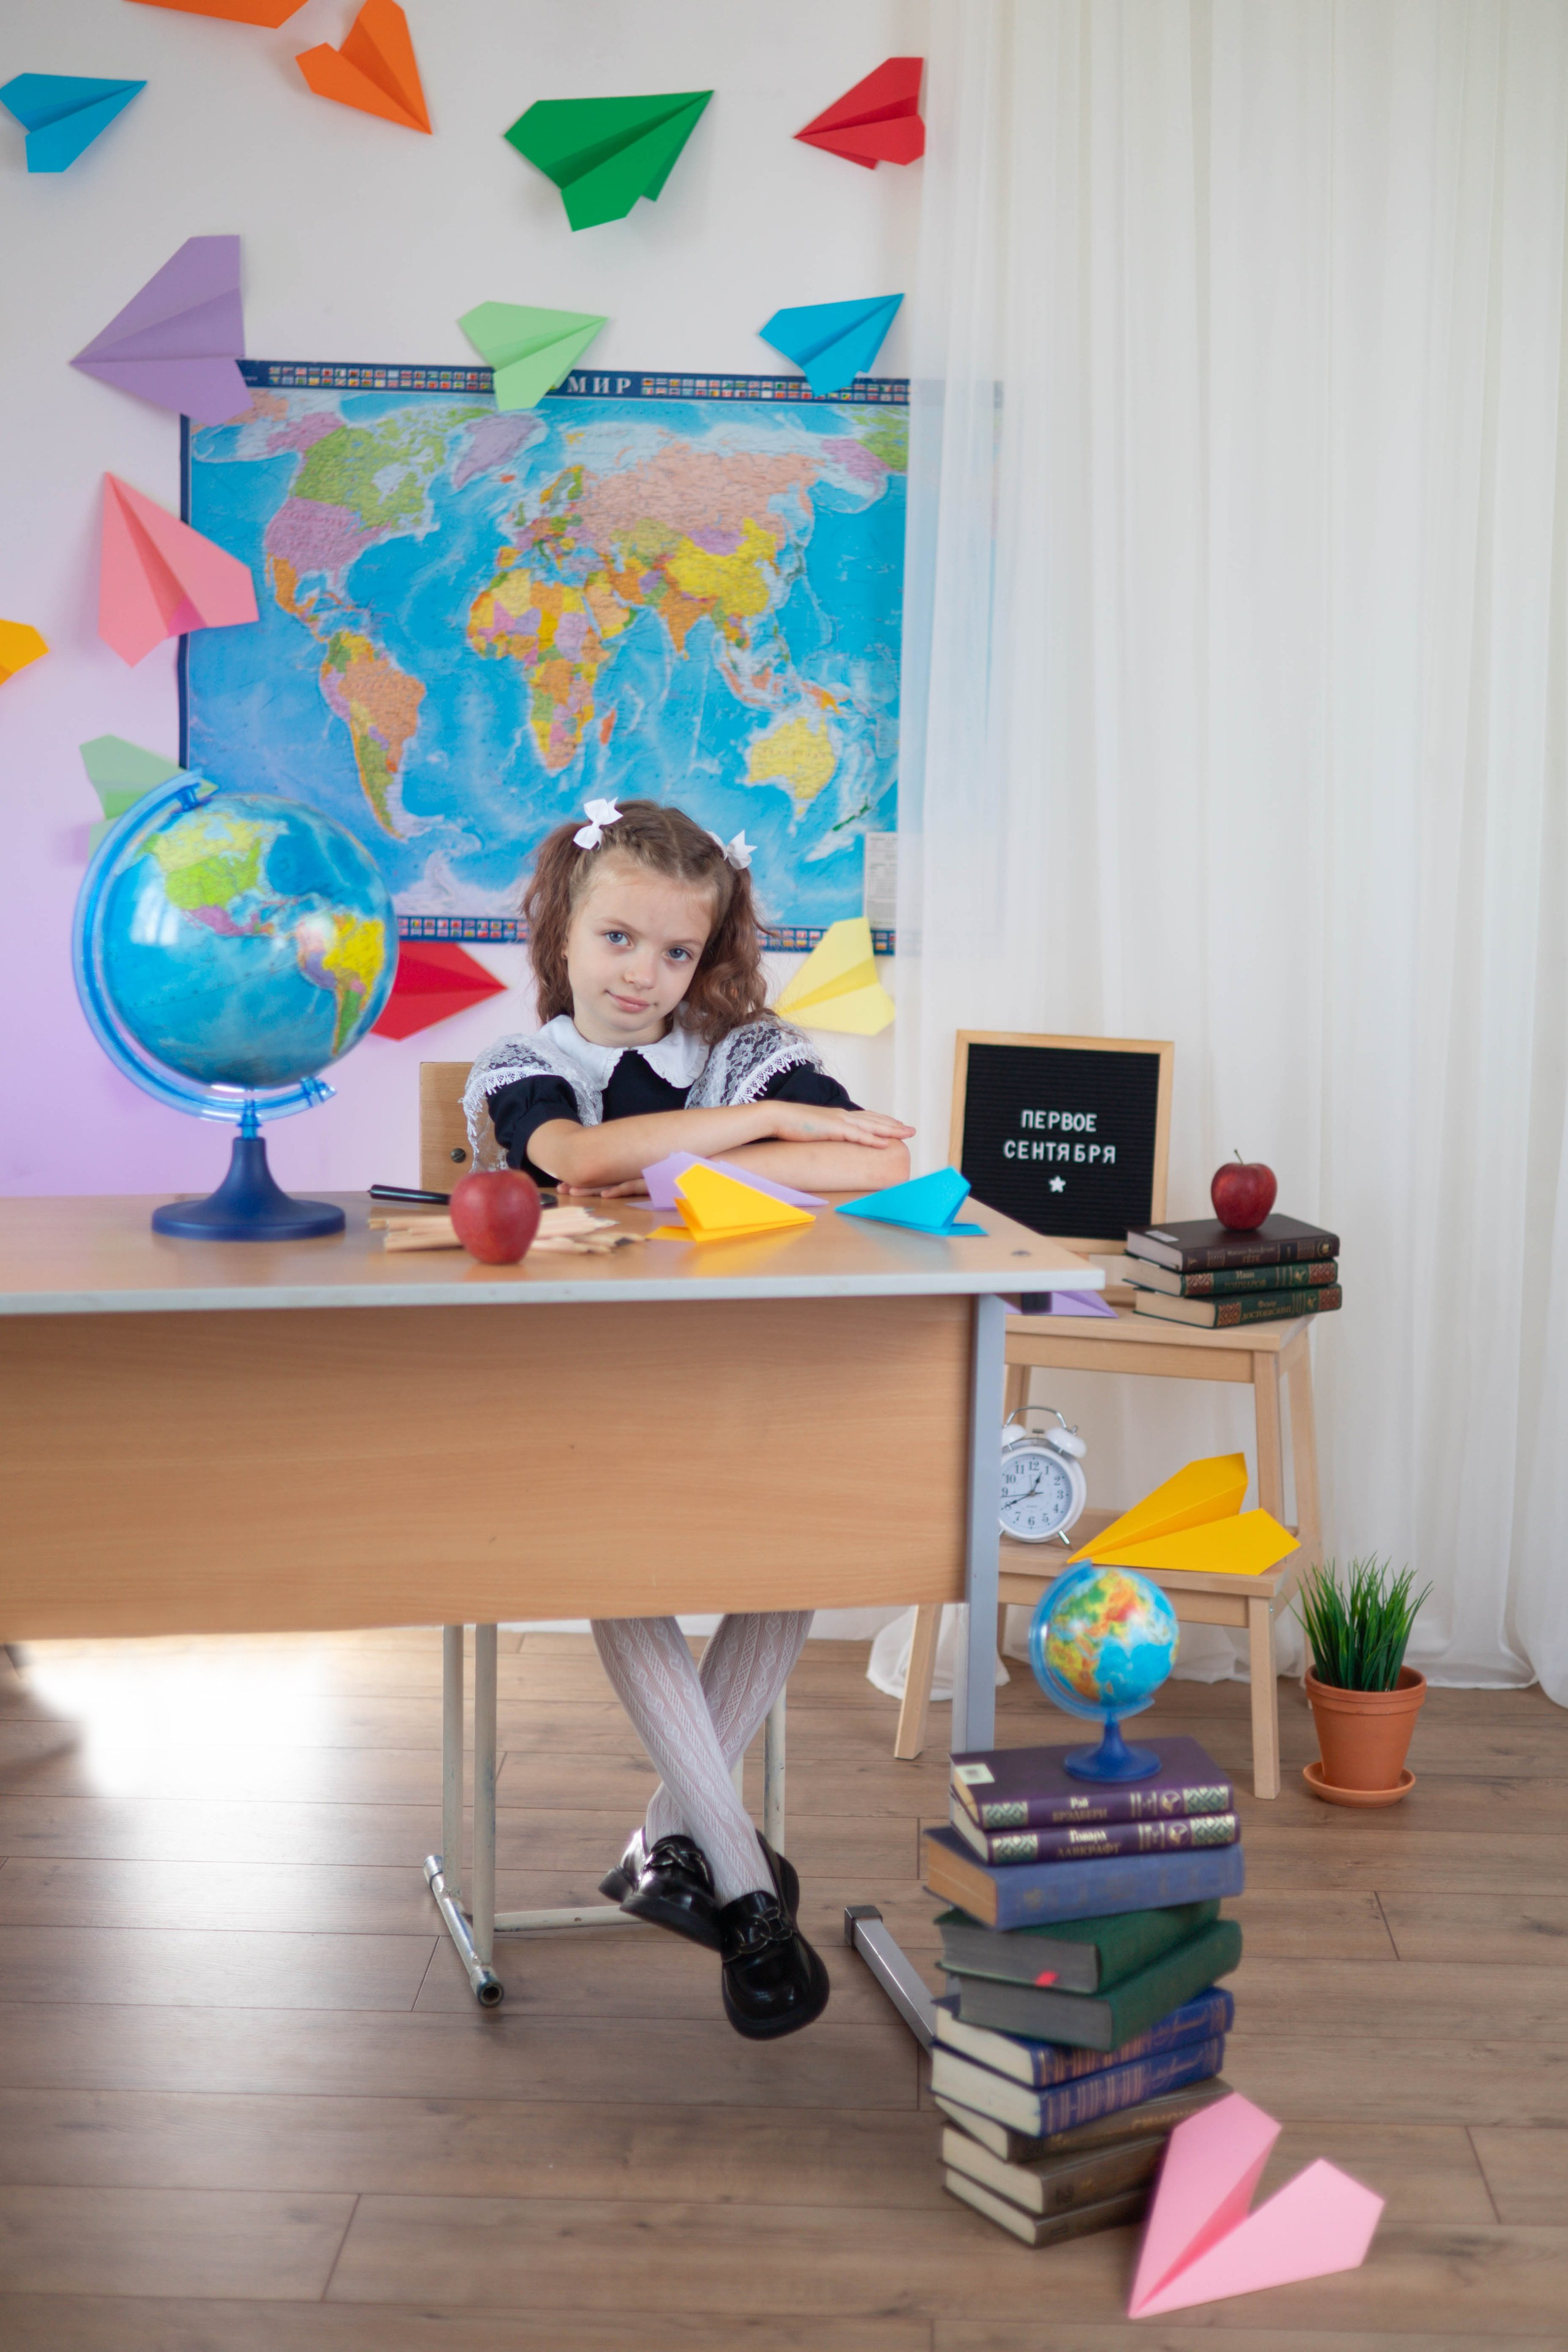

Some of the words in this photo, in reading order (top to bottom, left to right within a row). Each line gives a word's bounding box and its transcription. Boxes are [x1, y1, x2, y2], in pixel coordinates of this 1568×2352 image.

[567, 376, 631, 394] МИР
[1021, 1109, 1097, 1132] ПЕРВОЕ
[1003, 1139, 1116, 1164] СЕНТЯБРЯ
[1016, 1464, 1024, 1474] 11
[1029, 1461, 1039, 1471] 12
[1045, 1466, 1049, 1475] 1
[1005, 1474, 1016, 1484] 10
[1054, 1476, 1060, 1485] 2
[1001, 1487, 1008, 1498] 9
[1057, 1490, 1063, 1499] 3
[1005, 1501, 1012, 1511] 8
[1053, 1504, 1058, 1513] 4
[1015, 1512, 1021, 1521] 7
[1028, 1516, 1035, 1525] 6
[1042, 1513, 1049, 1523] 5
[1070, 1829, 1107, 1844] Говард
